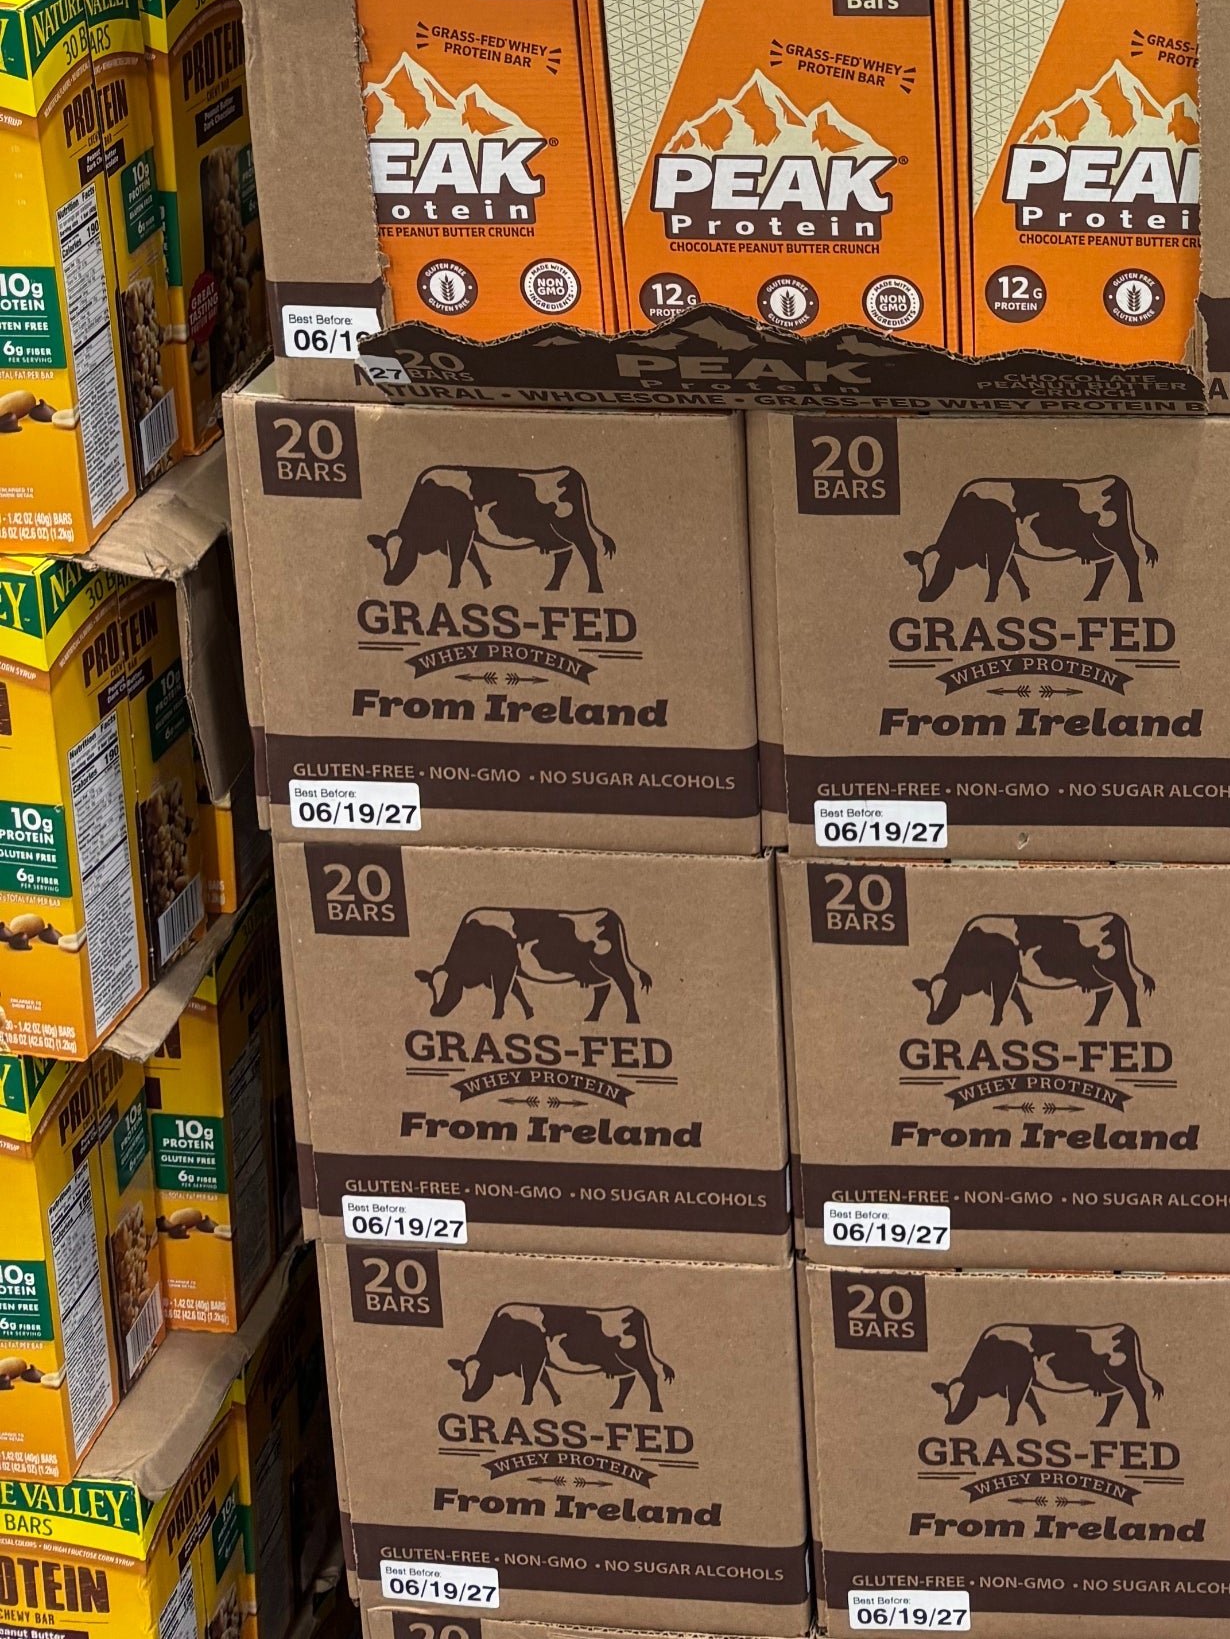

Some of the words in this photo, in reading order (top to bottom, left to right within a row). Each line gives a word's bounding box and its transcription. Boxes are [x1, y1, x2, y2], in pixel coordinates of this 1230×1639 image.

[62, 36, 79, 66] 30
[78, 23, 111, 58] BARS
[272, 418, 344, 460] 20
[277, 461, 348, 483] BARS
[356, 599, 638, 644] GRASS-FED
[419, 645, 480, 670] WHEY
[487, 645, 582, 676] PROTEIN
[352, 688, 475, 721] From
[484, 694, 669, 728] Ireland
[293, 762, 415, 779] GLUTEN-FREE
[430, 765, 521, 783] NON-GMO
[540, 770, 569, 785] NO
[572, 771, 634, 788] SUGAR
[639, 772, 736, 790] ALCOHOLS
[294, 787, 318, 798] Best
[320, 788, 357, 799] Before:
[298, 803, 418, 825] 06/19/27
[175, 1120, 214, 1141] 10g
[162, 1138, 215, 1150] PROTEIN
[161, 1154, 194, 1164] GLUTEN
[196, 1156, 216, 1165] FREE
[19, 1482, 128, 1529] VALLEY
[5, 1513, 53, 1536] BARS
